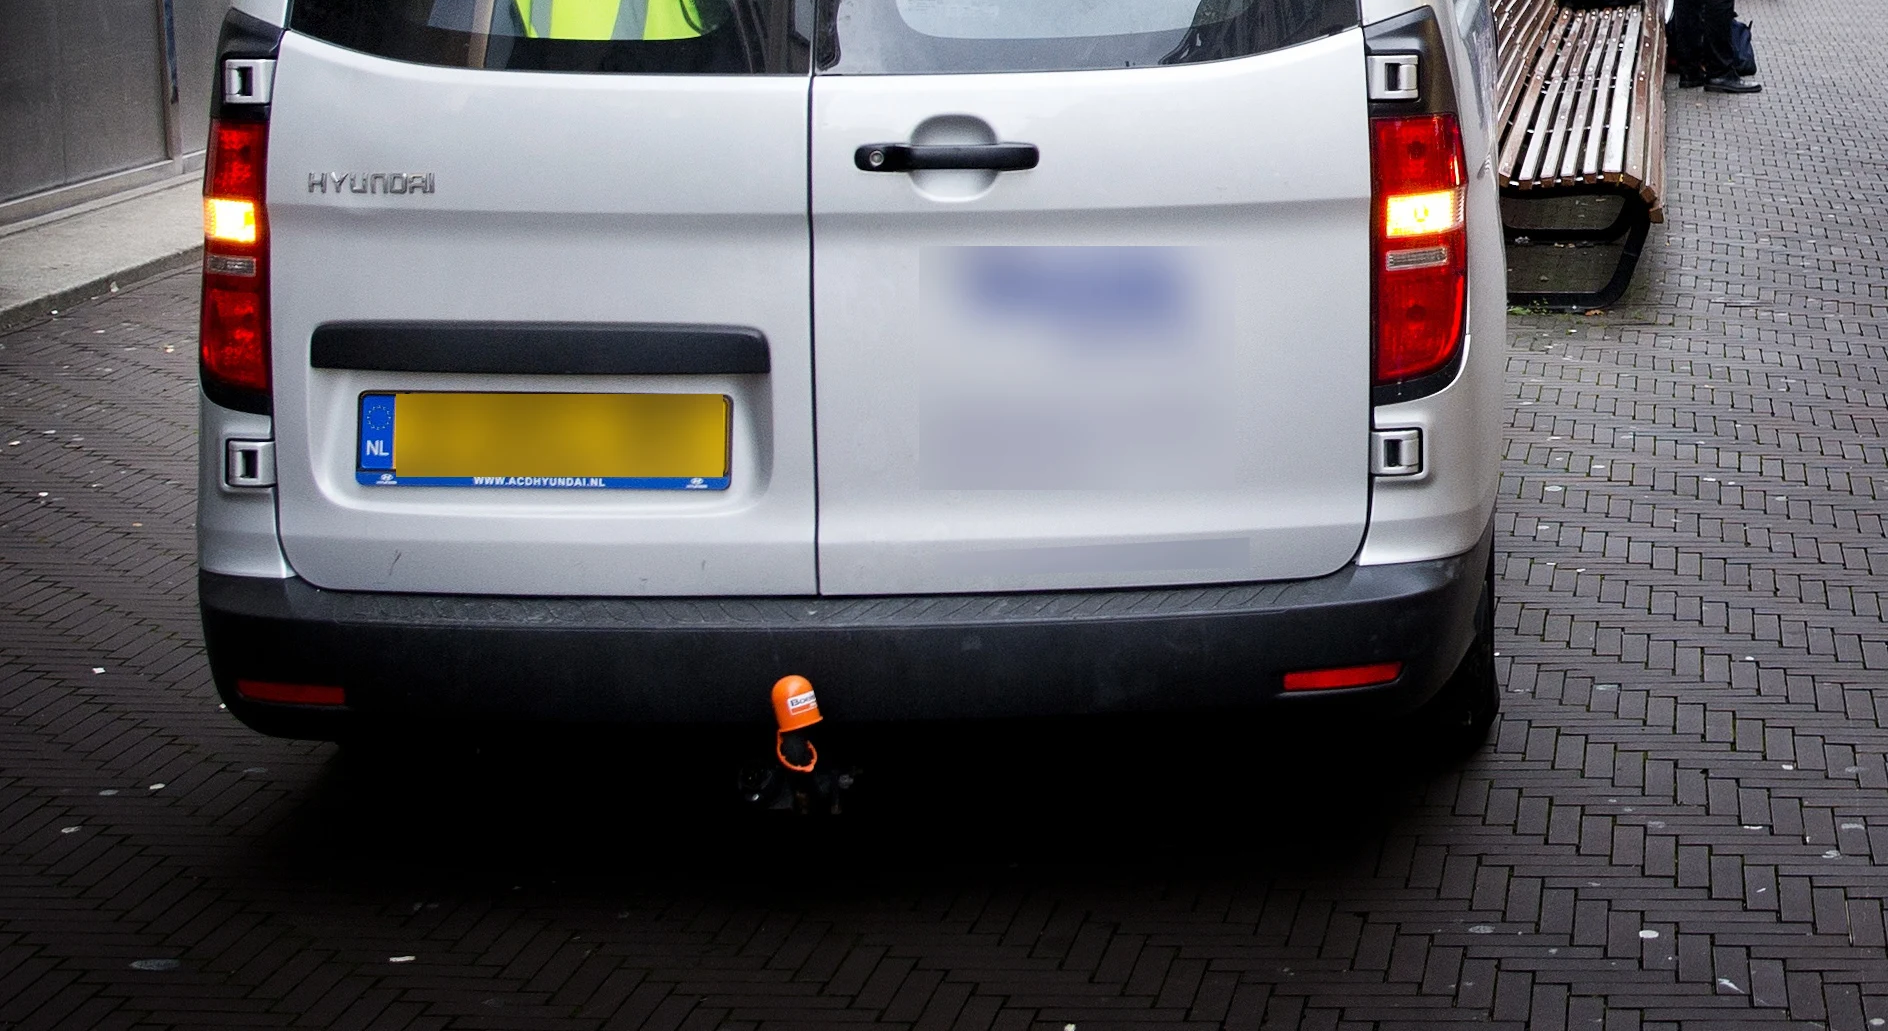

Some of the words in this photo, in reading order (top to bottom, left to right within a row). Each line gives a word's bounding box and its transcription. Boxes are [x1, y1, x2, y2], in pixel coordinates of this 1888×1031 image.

[308, 172, 435, 194] HYUNDAI
[366, 440, 389, 457] NL
[473, 476, 606, 487] WWW.ACDHYUNDAI.NL
